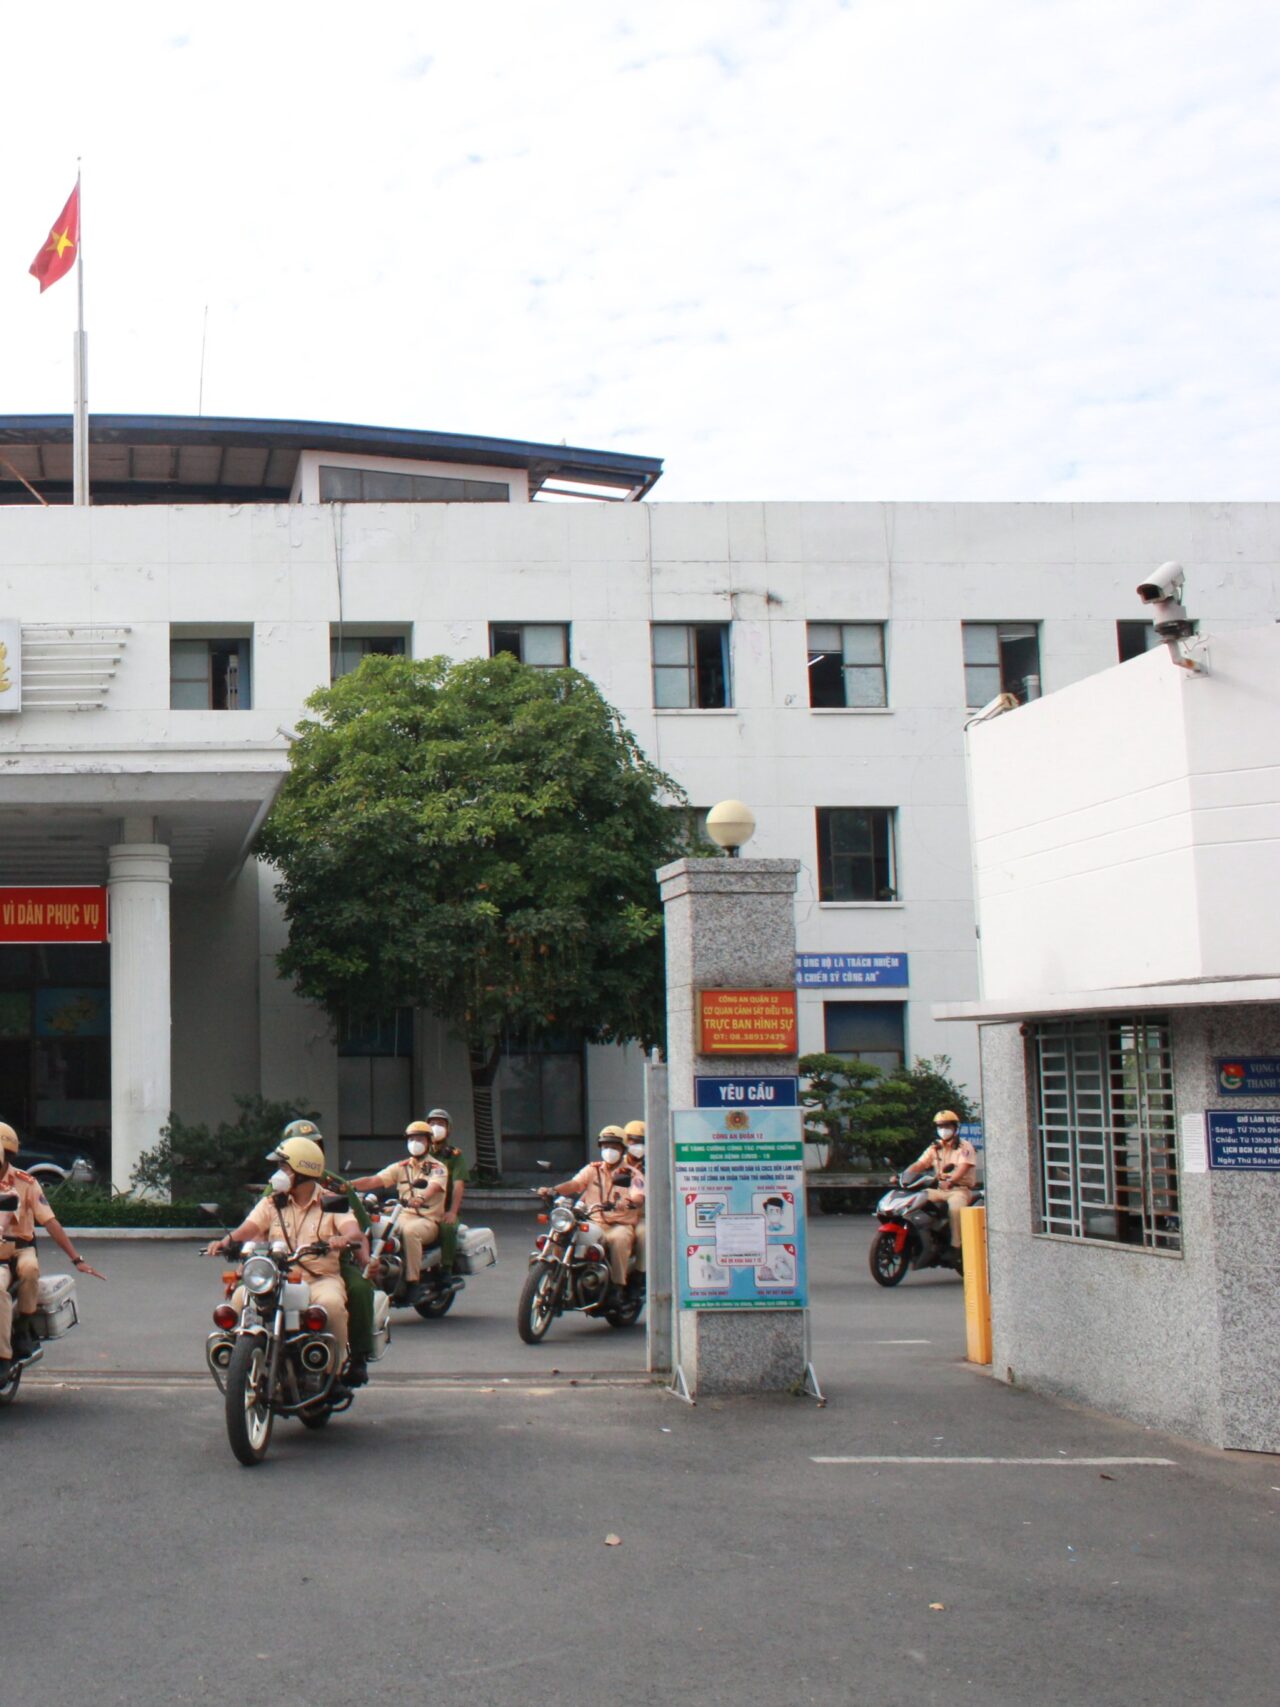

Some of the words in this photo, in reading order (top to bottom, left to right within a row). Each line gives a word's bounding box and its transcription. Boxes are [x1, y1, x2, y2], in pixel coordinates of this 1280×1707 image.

[3, 900, 15, 925] VÌ
[18, 899, 43, 925] DÂN
[47, 904, 80, 929] PHỤC
[83, 904, 99, 929] VỤ
[842, 970, 863, 982] CÔNG
[704, 1019, 730, 1031] TRỰC
[732, 1019, 752, 1029] BAN
[754, 1017, 778, 1029] HÌNH
[780, 1019, 793, 1032] SỰ
[719, 1083, 744, 1100] YÊU
[1249, 1115, 1264, 1123] LÀM
[786, 1193, 793, 1202] 2
[688, 1247, 695, 1255] 3
